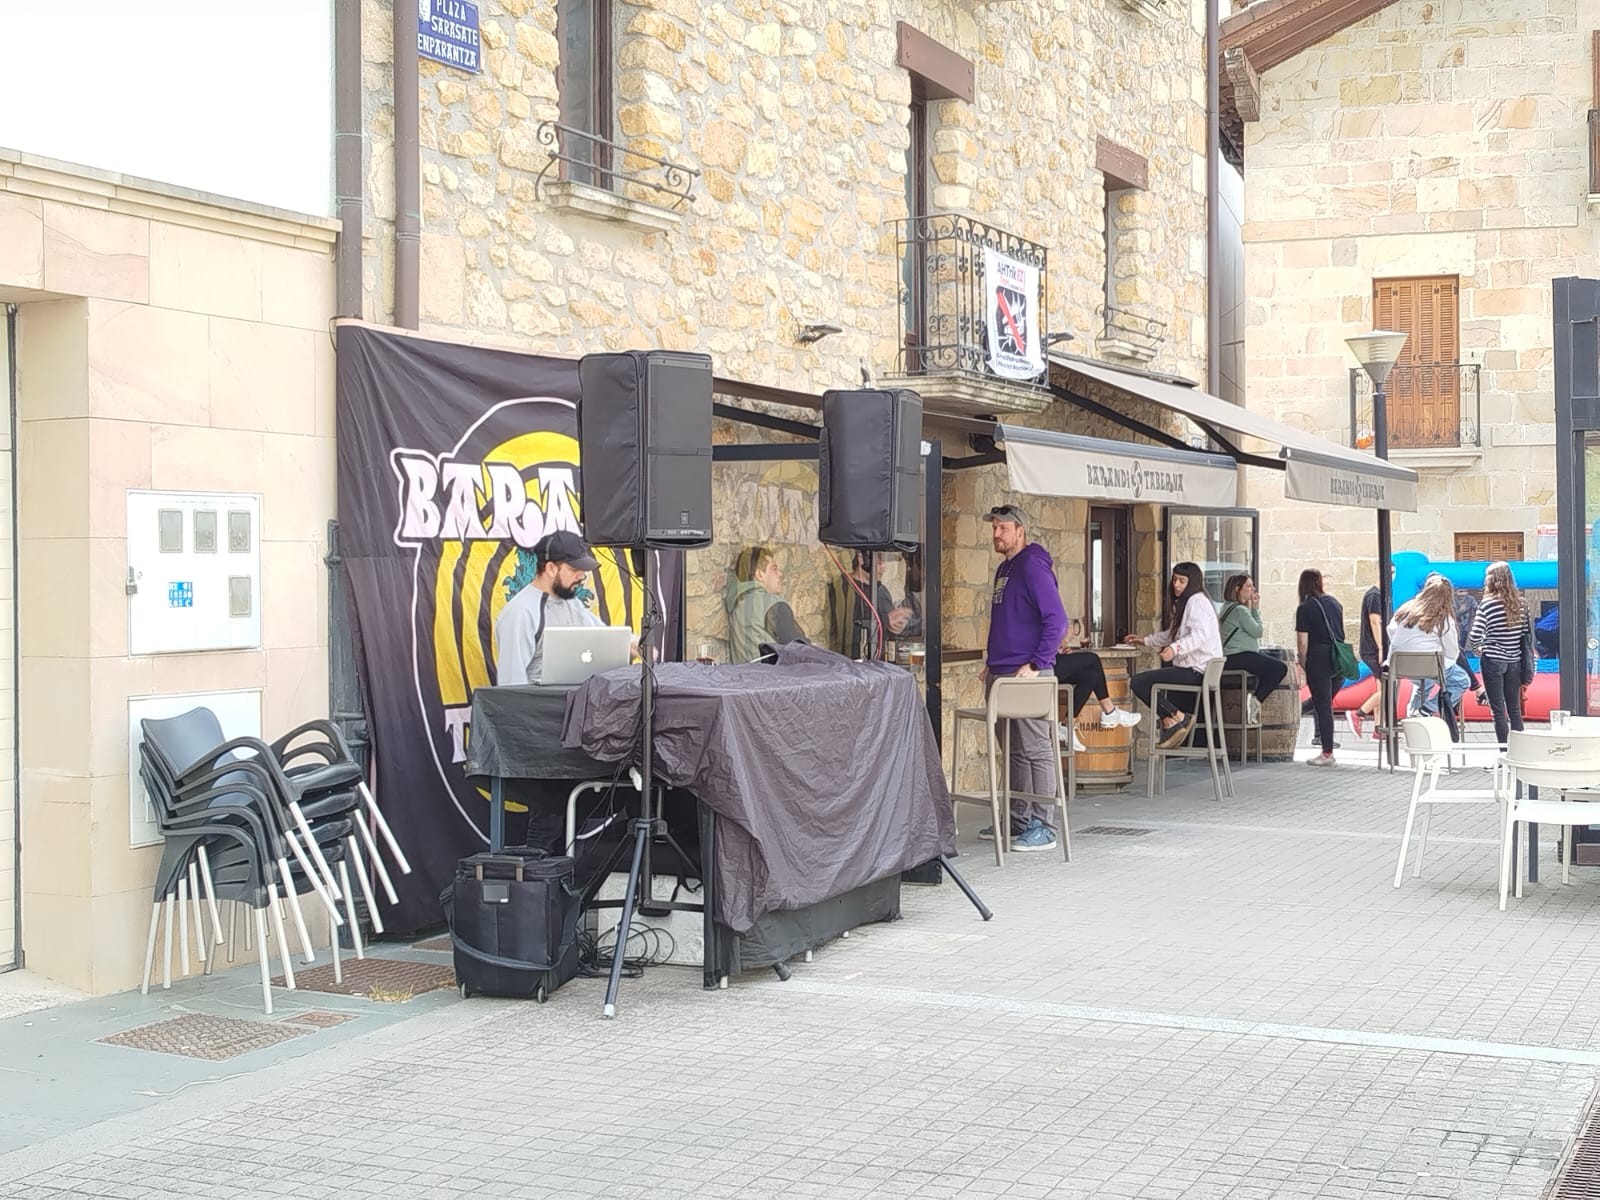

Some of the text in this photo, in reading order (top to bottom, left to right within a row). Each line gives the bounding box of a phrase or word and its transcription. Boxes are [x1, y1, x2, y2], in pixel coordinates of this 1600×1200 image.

[436, 0, 466, 21] PLAZA
[431, 15, 478, 46] SARASATE
[417, 33, 476, 67] ENPARANTZA
[1143, 470, 1184, 493] TABERNA
[401, 456, 582, 548] BARA
